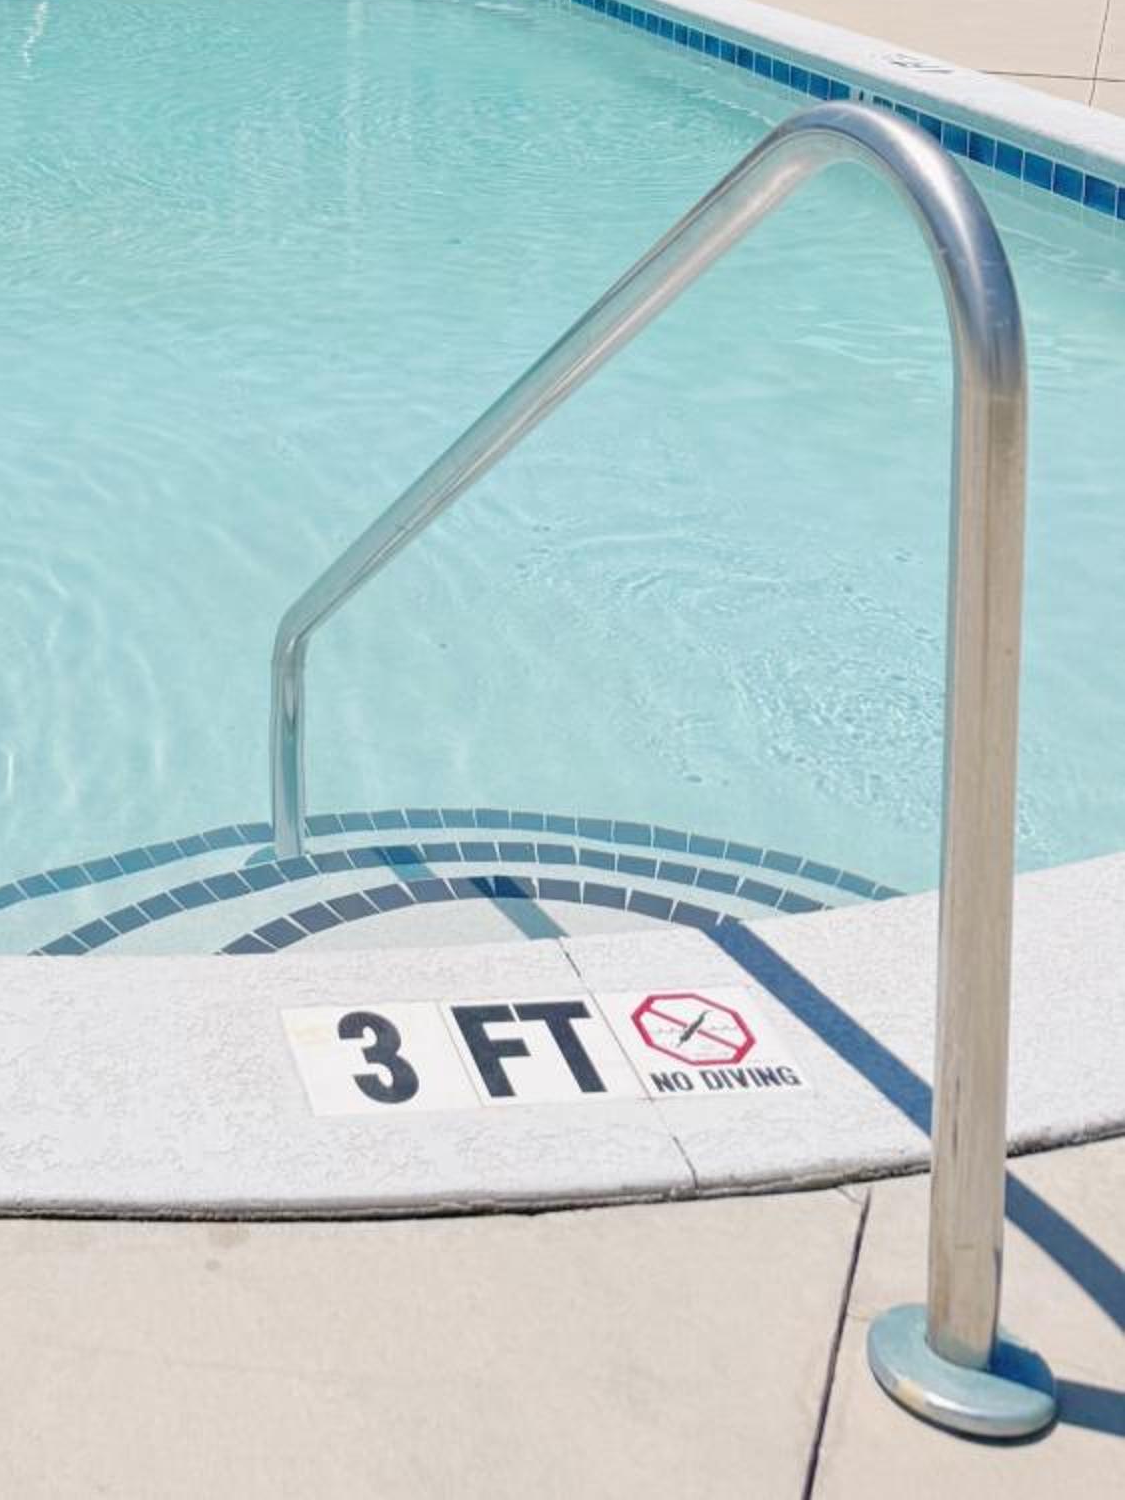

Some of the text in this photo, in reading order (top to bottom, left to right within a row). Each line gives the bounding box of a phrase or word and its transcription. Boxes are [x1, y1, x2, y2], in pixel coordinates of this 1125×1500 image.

[337, 1000, 607, 1104] 3 FT
[650, 1065, 801, 1093] NO DIVING
